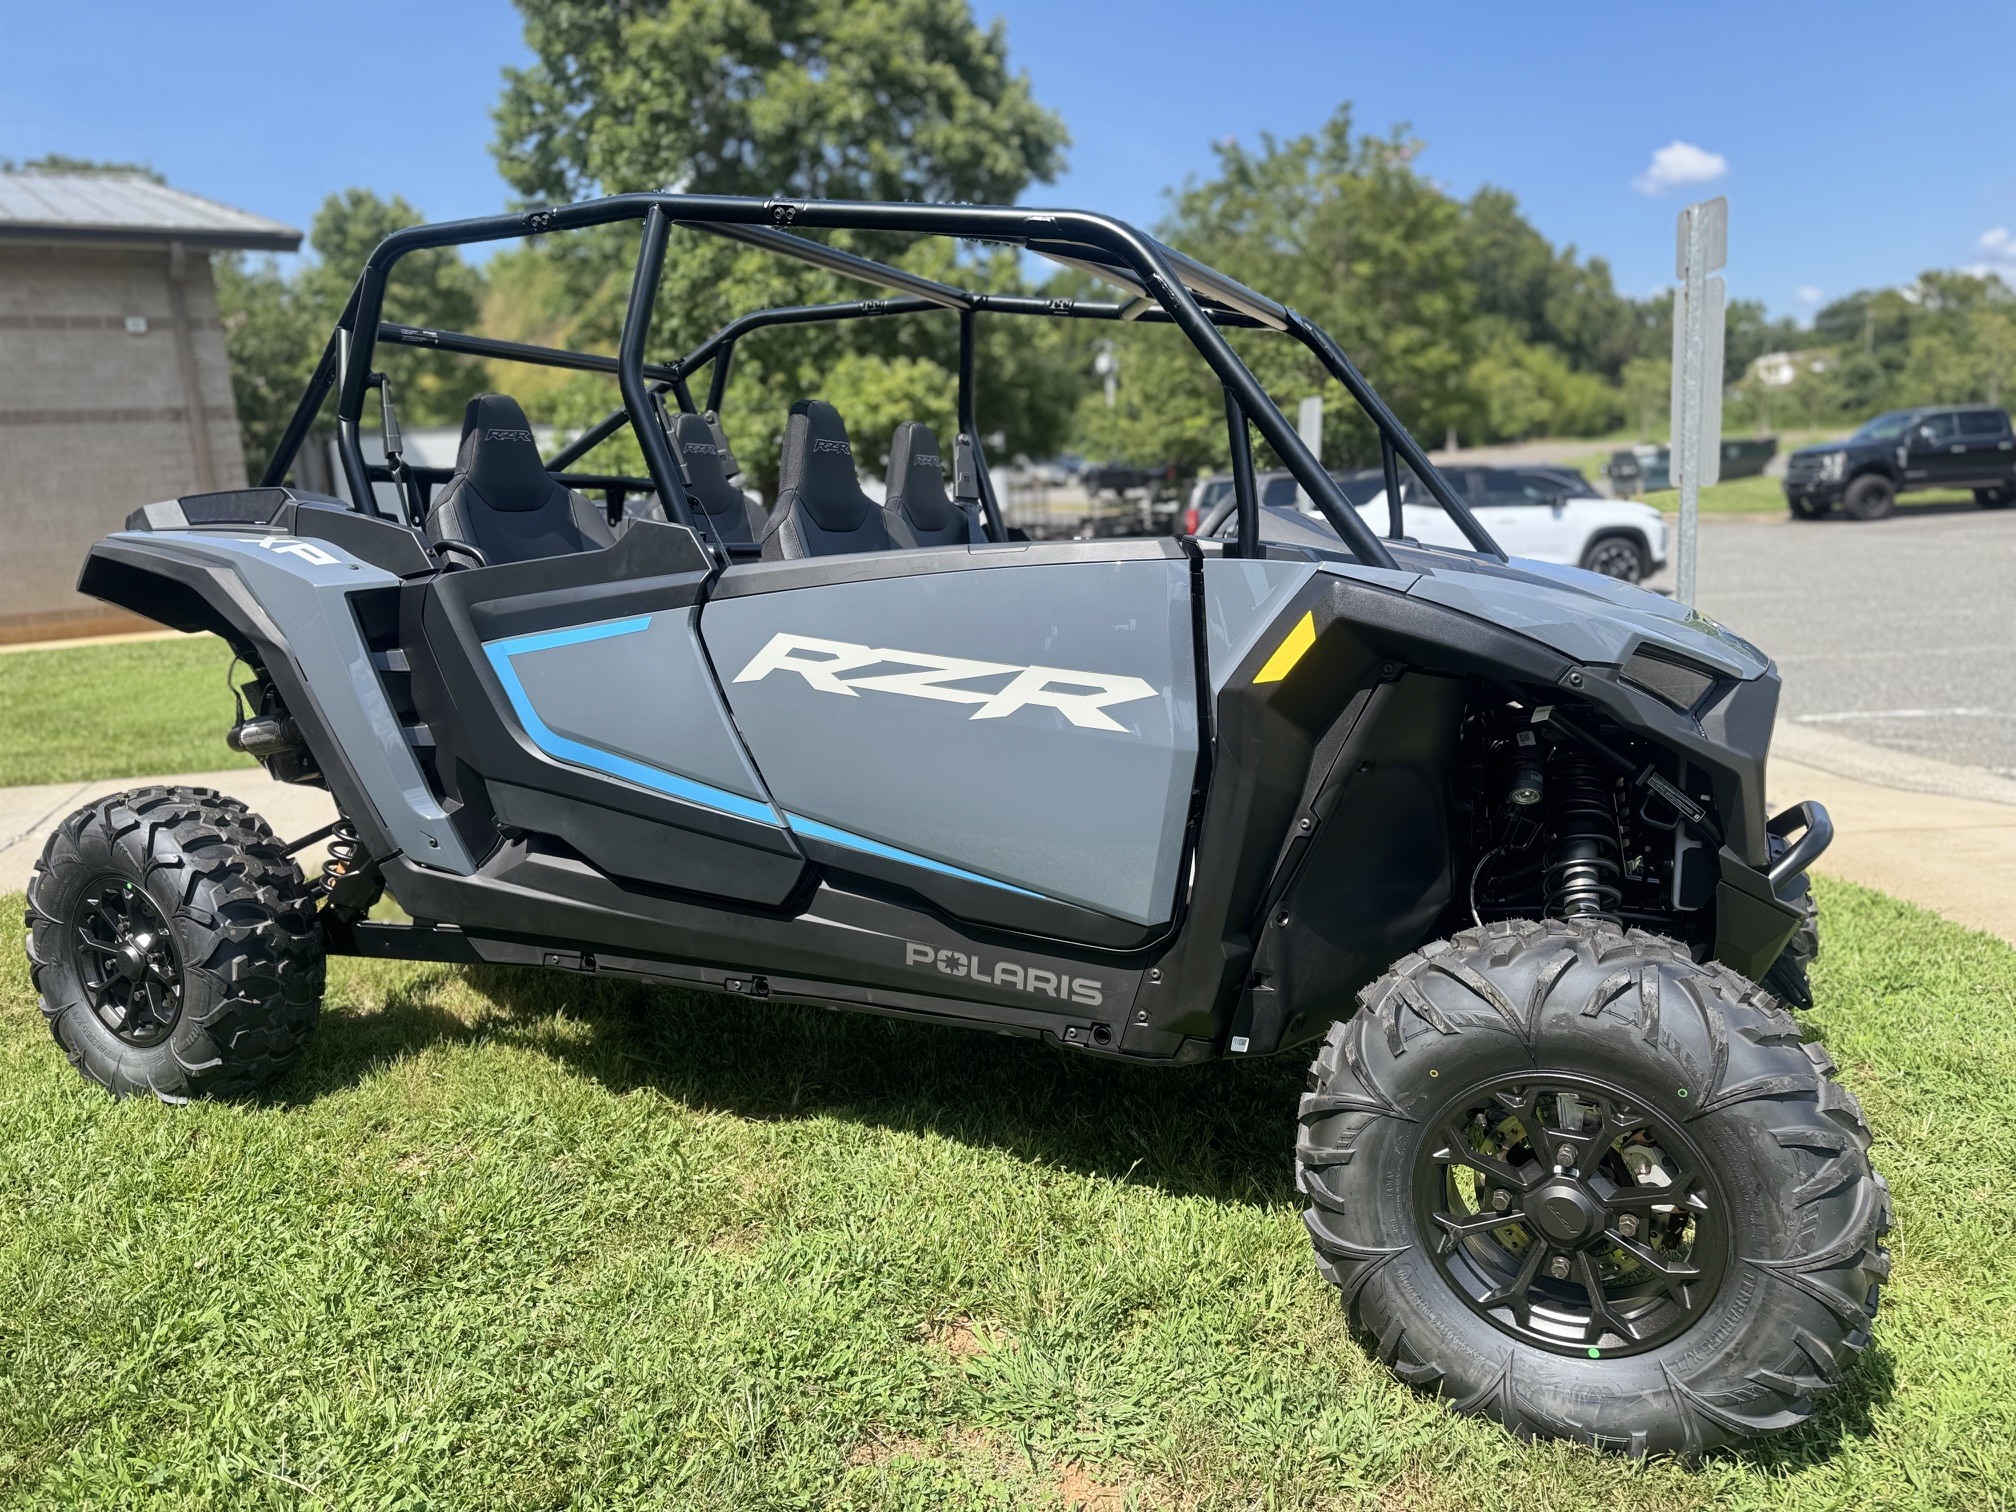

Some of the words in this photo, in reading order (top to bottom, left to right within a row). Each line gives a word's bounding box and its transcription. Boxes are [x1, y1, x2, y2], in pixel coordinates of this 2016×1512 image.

[484, 428, 532, 442] RZR
[683, 442, 717, 455] RZR
[813, 438, 851, 455] RZR
[913, 454, 941, 467] RZR
[233, 535, 342, 566] XP
[731, 632, 1159, 734] RZR
[905, 941, 1104, 1007] POLARIS
